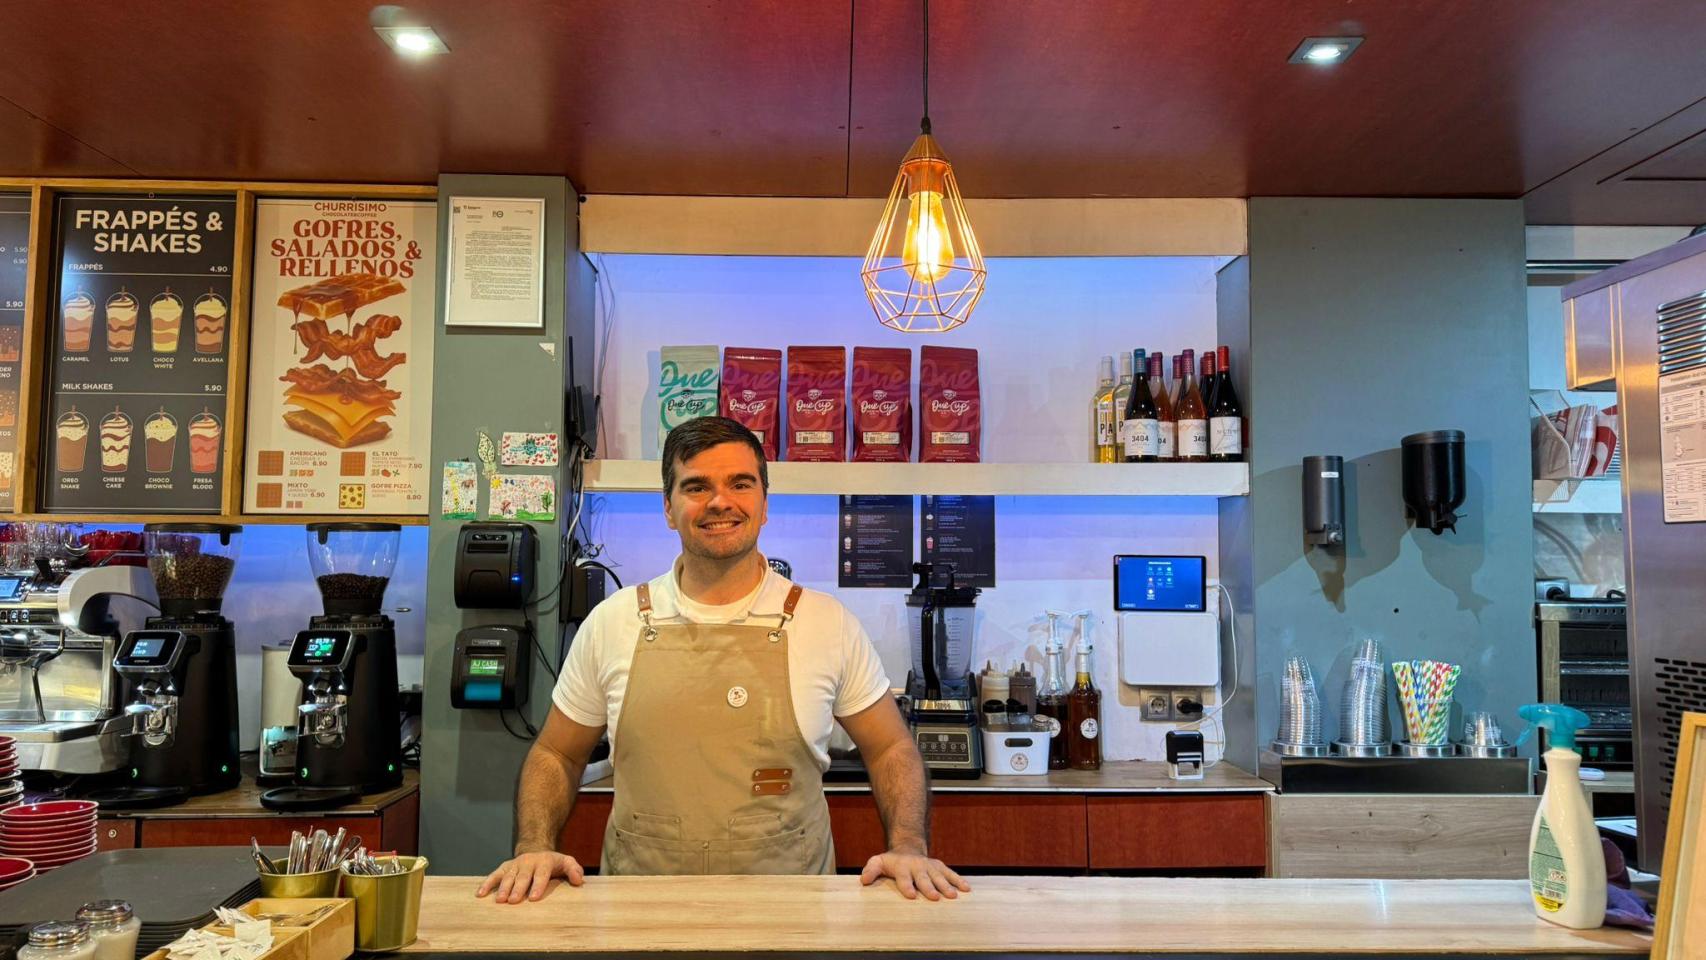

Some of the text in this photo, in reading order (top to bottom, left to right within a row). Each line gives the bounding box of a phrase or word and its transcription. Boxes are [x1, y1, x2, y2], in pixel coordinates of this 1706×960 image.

[75, 205, 223, 231] FRAPPÉS &
[293, 219, 402, 241] GOFRES,
[94, 232, 202, 253] SHAKES
[271, 239, 422, 260] SALADOS &
[68, 263, 103, 271] FRAPPÉS
[209, 265, 228, 273] 4.90
[279, 258, 414, 278] RELLENOS
